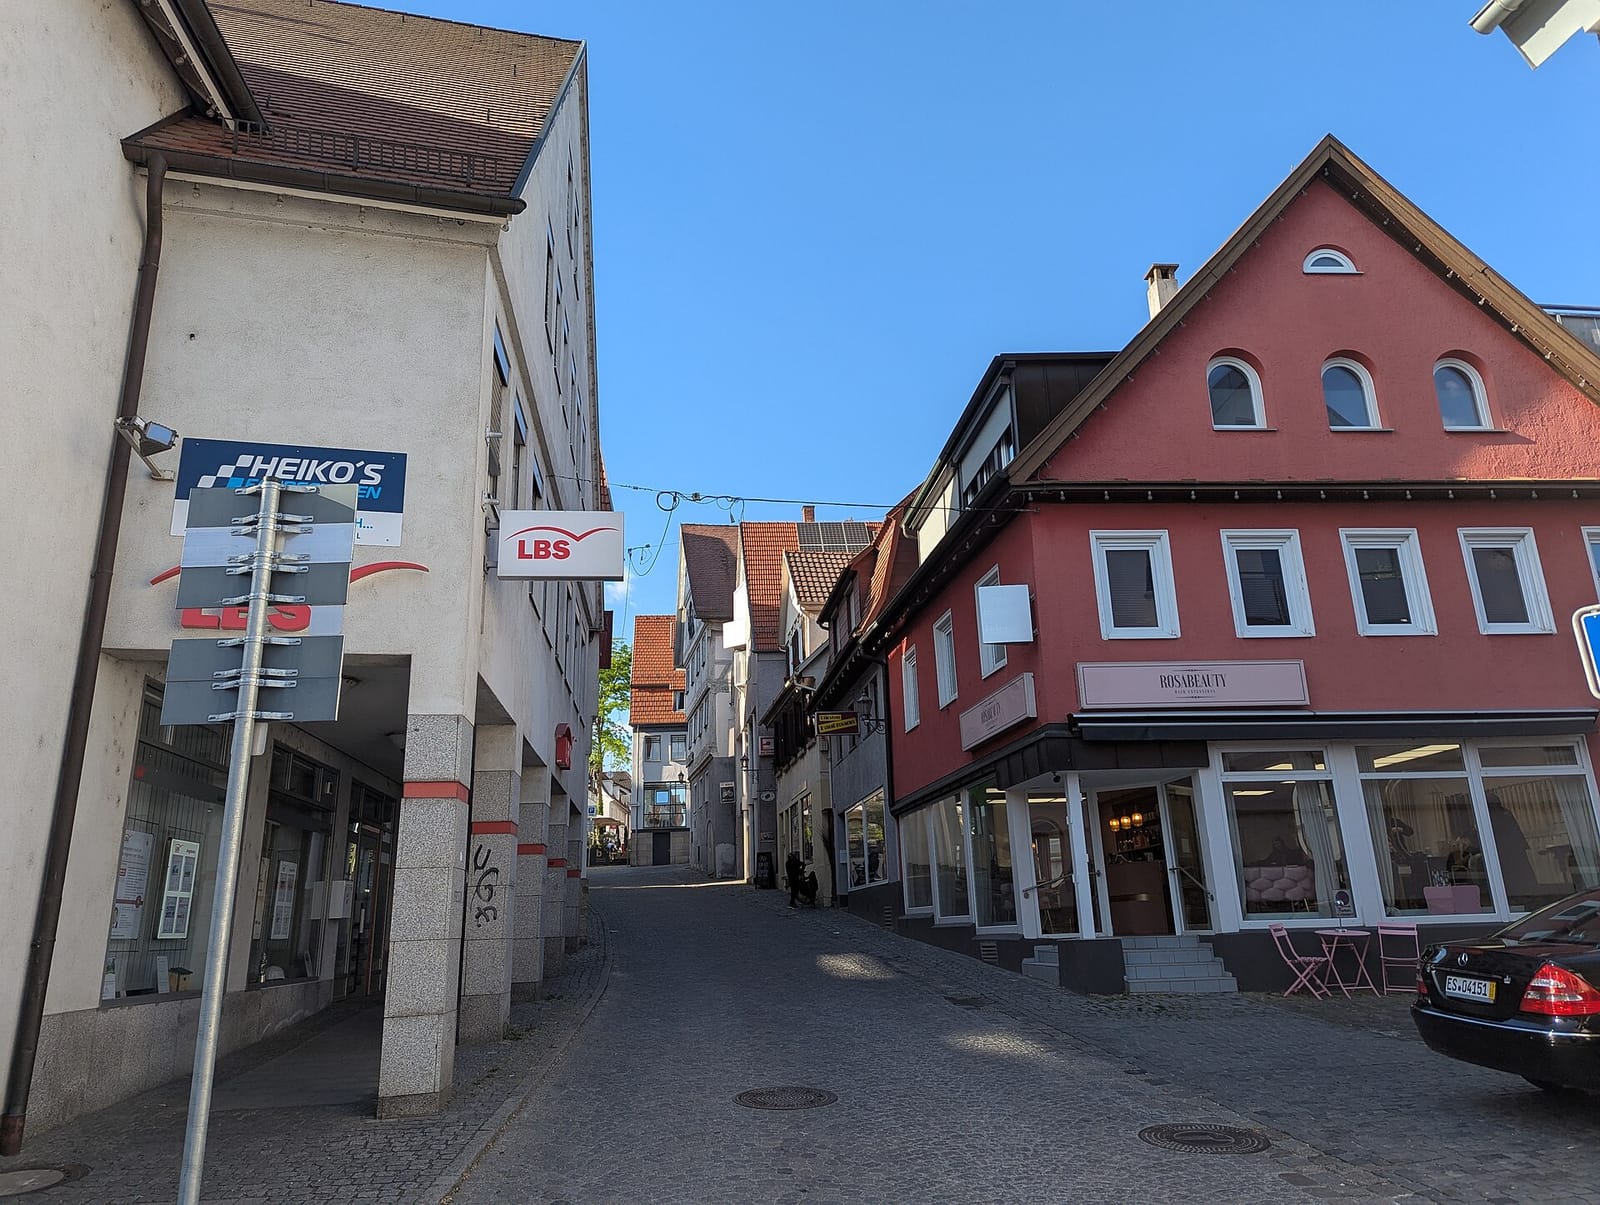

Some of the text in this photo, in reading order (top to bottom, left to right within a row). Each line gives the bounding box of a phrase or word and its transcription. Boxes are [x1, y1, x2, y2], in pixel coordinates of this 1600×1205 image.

[517, 539, 571, 560] LBS
[1159, 673, 1227, 689] ROSABEAUTY
[1447, 977, 1458, 991] ES
[1461, 980, 1488, 997] 04151
